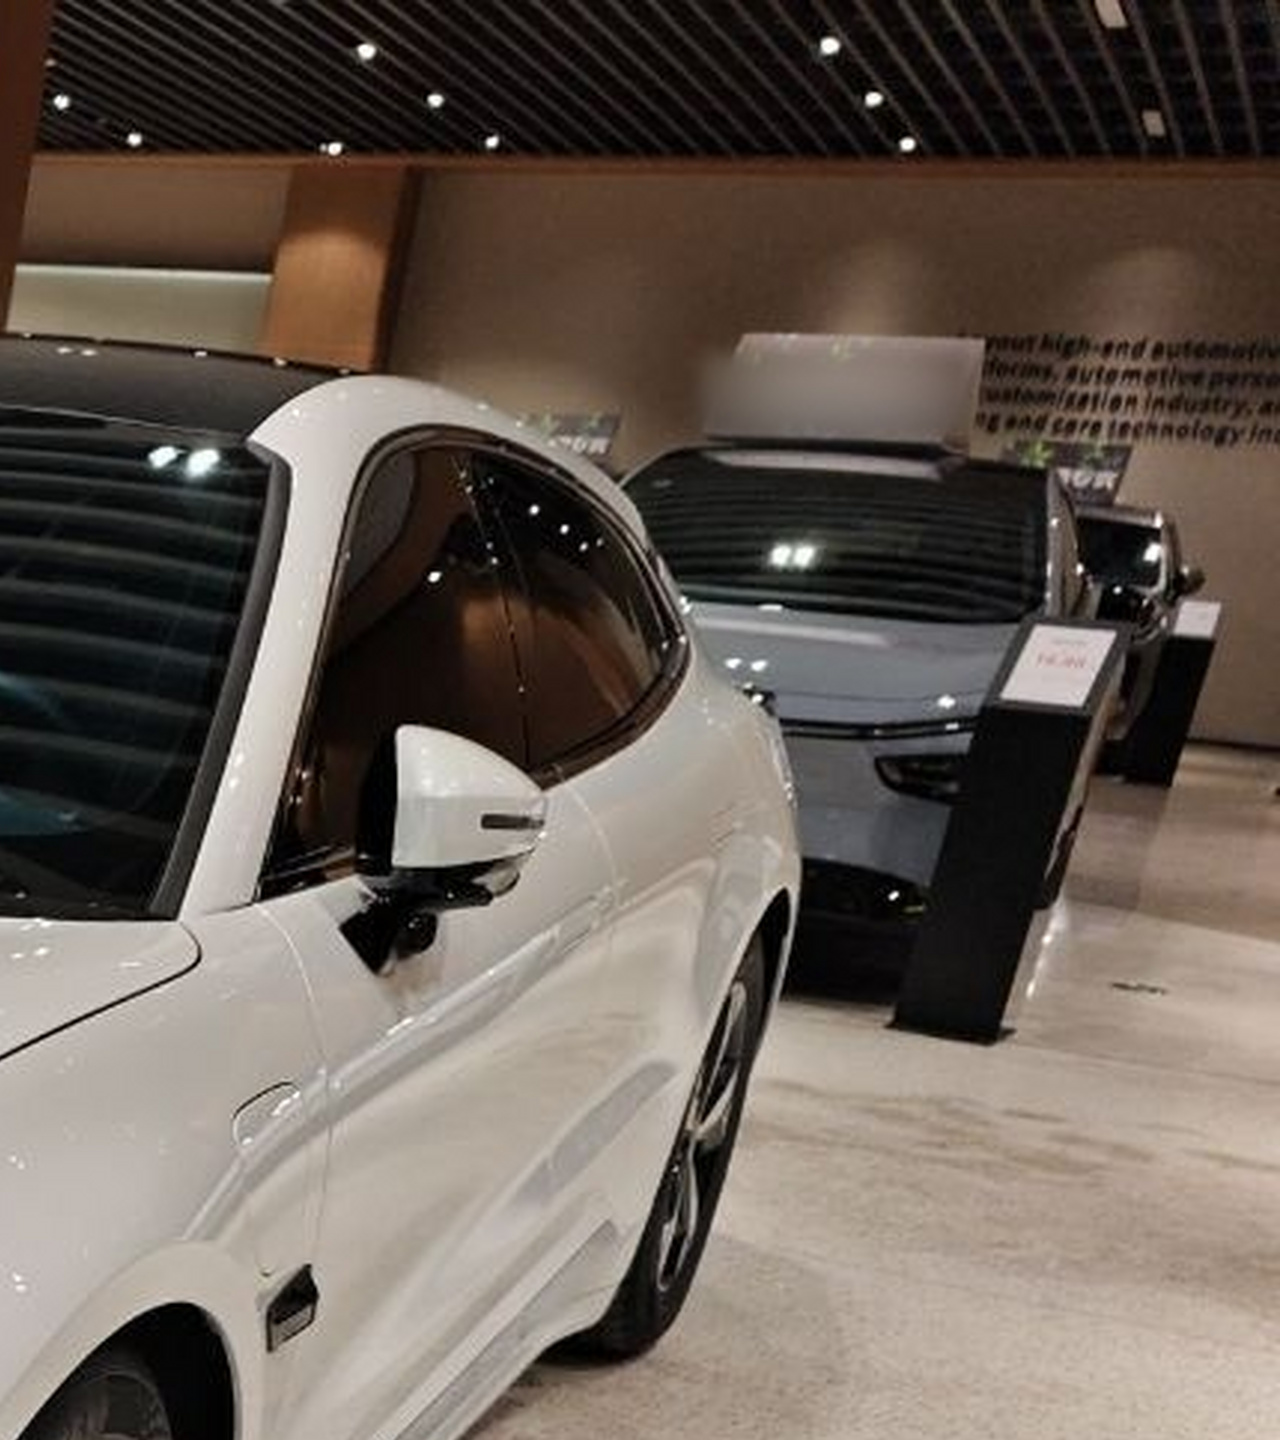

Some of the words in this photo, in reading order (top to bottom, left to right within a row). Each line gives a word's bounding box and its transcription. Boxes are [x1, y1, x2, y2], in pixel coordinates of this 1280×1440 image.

[1040, 331, 1147, 360] high-end
[1065, 364, 1204, 388] automotive
[1004, 412, 1050, 433] and
[1051, 416, 1103, 438] care
[1107, 419, 1239, 447] technology
